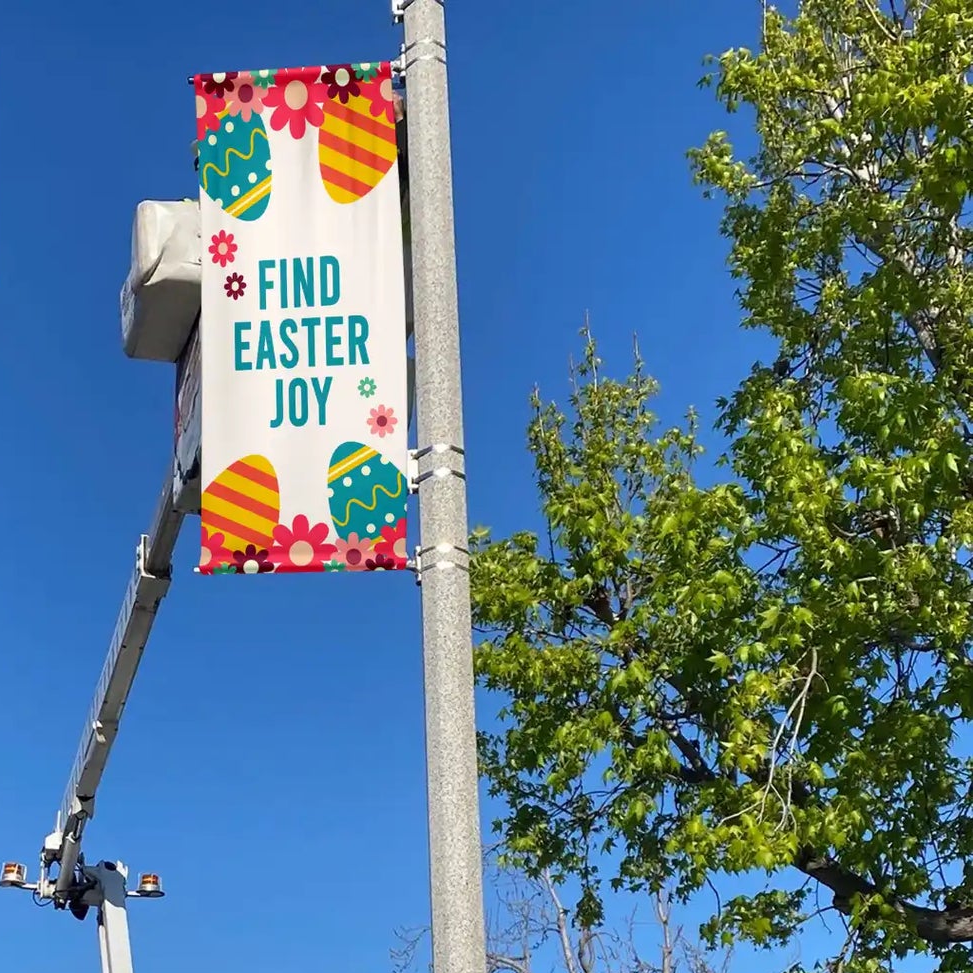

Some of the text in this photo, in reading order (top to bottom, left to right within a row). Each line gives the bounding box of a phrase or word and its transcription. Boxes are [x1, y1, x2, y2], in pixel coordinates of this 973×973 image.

[258, 255, 341, 310] FIND
[234, 315, 370, 371] EASTER
[270, 376, 333, 429] JOY
